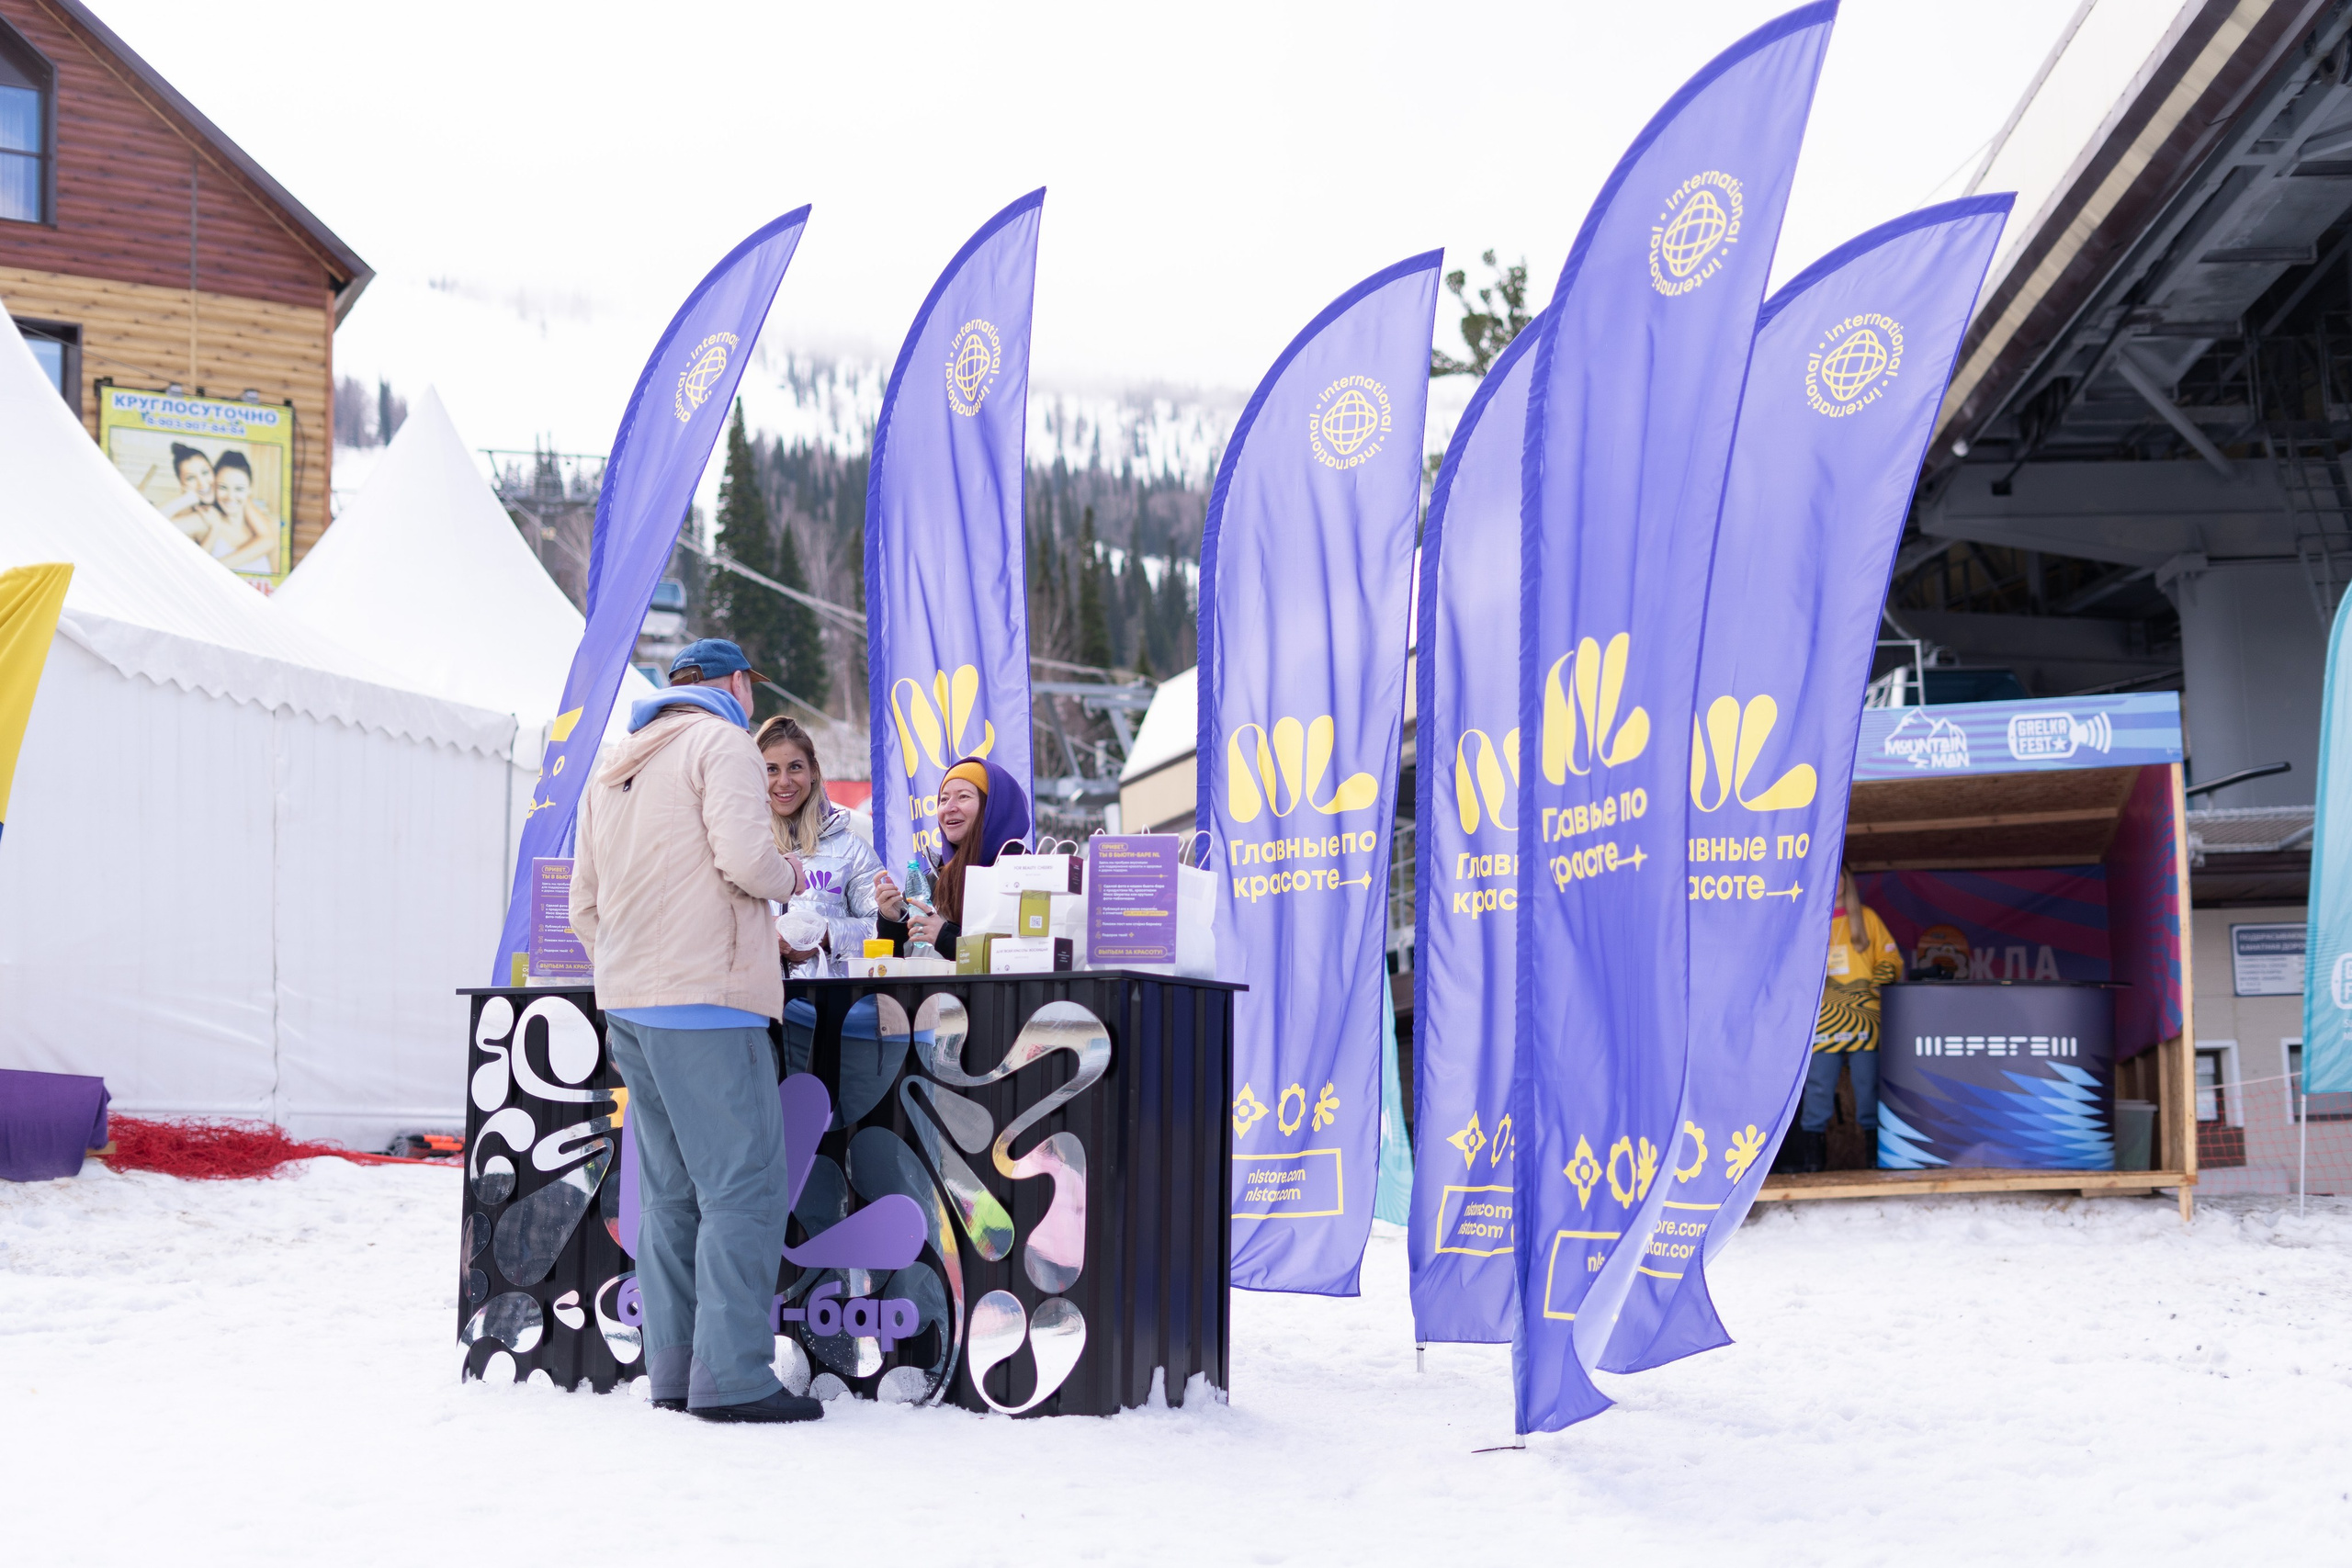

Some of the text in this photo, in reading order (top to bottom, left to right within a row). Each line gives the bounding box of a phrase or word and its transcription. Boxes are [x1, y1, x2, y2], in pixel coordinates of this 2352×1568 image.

[113, 394, 277, 424] КРУГЛОСУТОЧНО
[2018, 717, 2067, 737] GRELKA
[1884, 736, 1968, 756] MOUNTAIN
[2019, 737, 2052, 753] FEST
[1931, 751, 1971, 768] MAN
[1620, 787, 1647, 822] по
[1229, 829, 1376, 866] Главные по
[1776, 832, 1810, 860] по
[1233, 868, 1340, 904] красоте
[1247, 1168, 1306, 1184] nlstore.com
